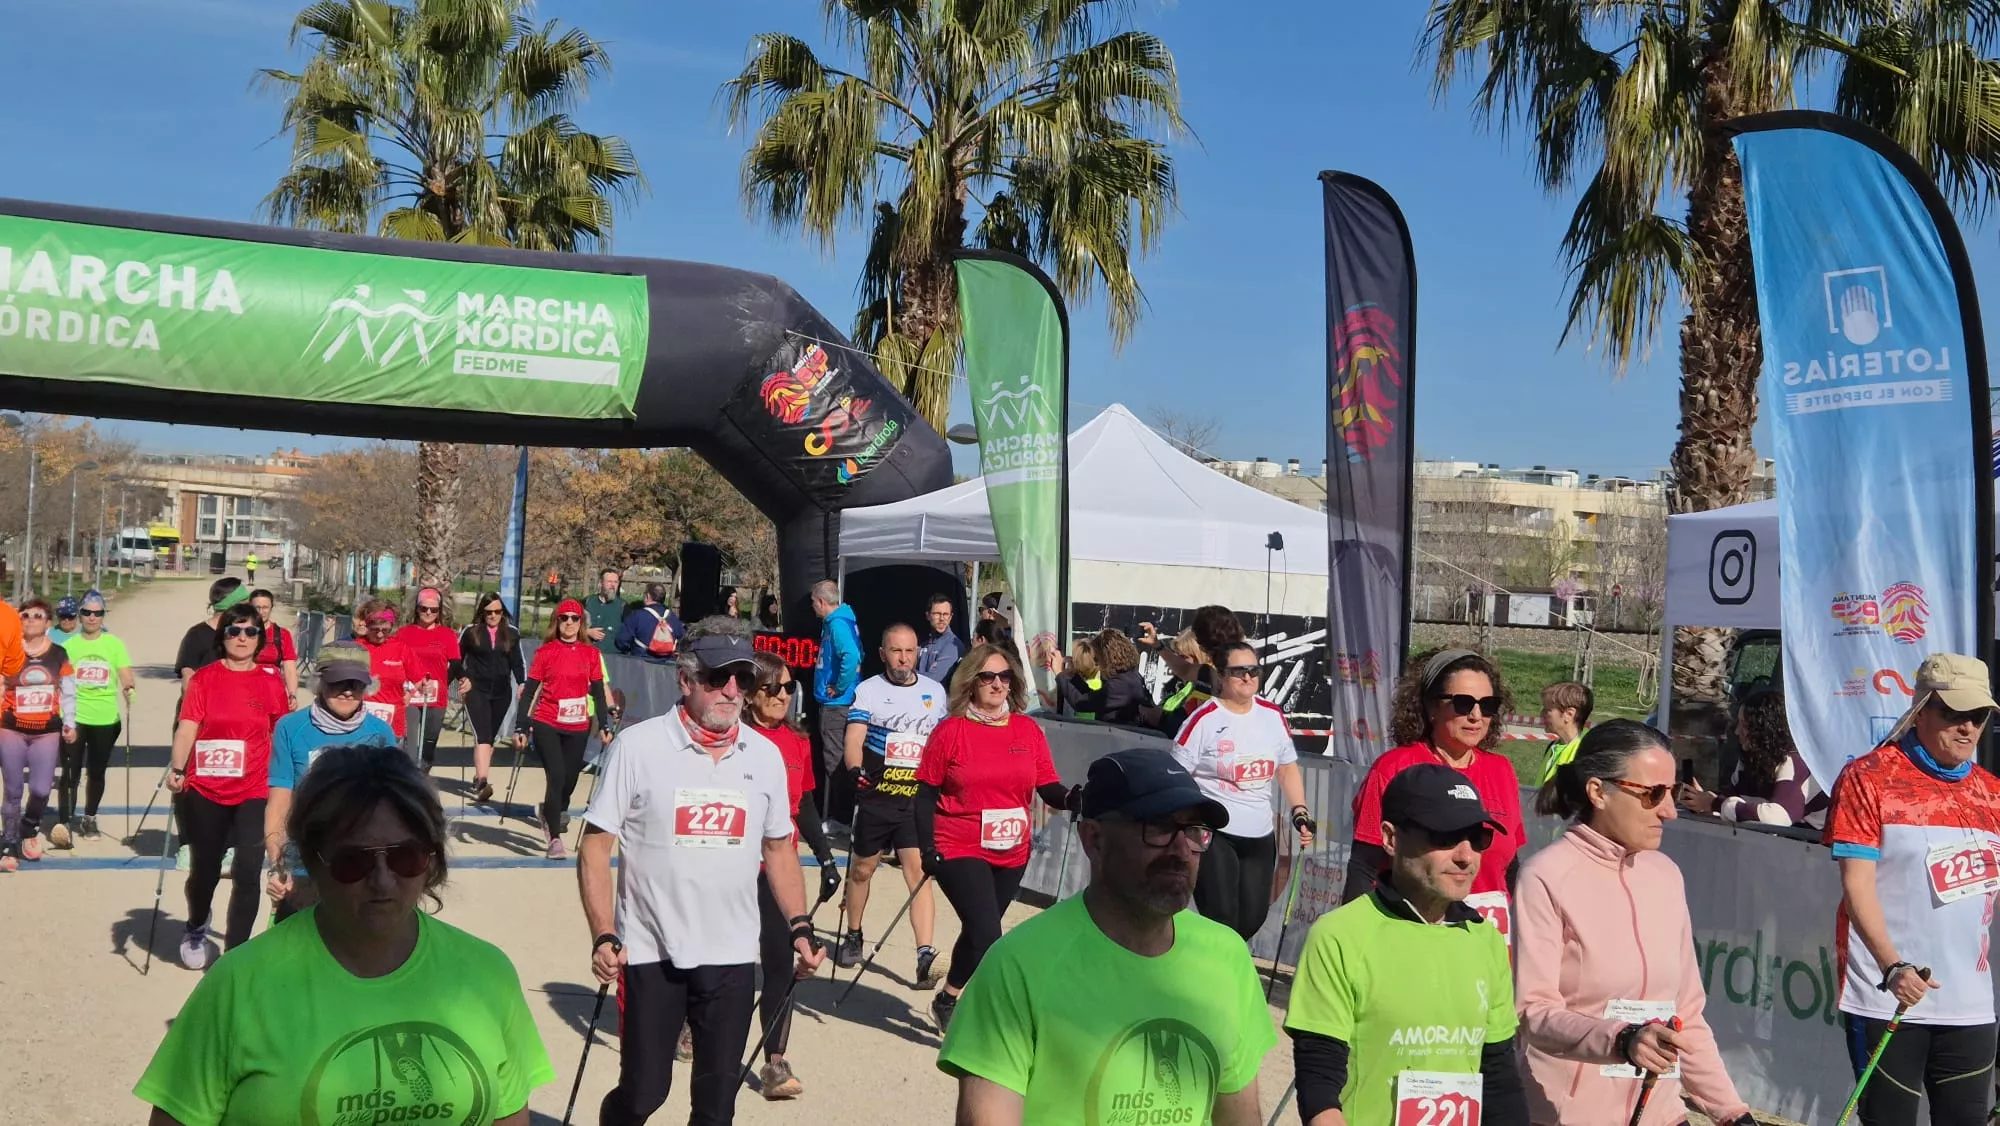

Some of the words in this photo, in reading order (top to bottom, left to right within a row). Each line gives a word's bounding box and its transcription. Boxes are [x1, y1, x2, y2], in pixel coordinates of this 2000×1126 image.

[0, 246, 243, 314] ARCHA
[457, 292, 614, 327] MARCHA
[455, 315, 621, 357] NÓRDICA
[460, 355, 528, 374] FEDME
[205, 751, 235, 765] 232
[893, 743, 920, 758] 209
[1242, 762, 1270, 778] 231
[688, 806, 735, 830] 227
[991, 820, 1021, 838] 230
[1941, 852, 1985, 884] 225
[336, 1088, 397, 1113] más
[1111, 1089, 1154, 1110] más
[371, 1102, 455, 1126] pasos
[1135, 1106, 1193, 1126] pasos
[1417, 1099, 1470, 1126] 221
